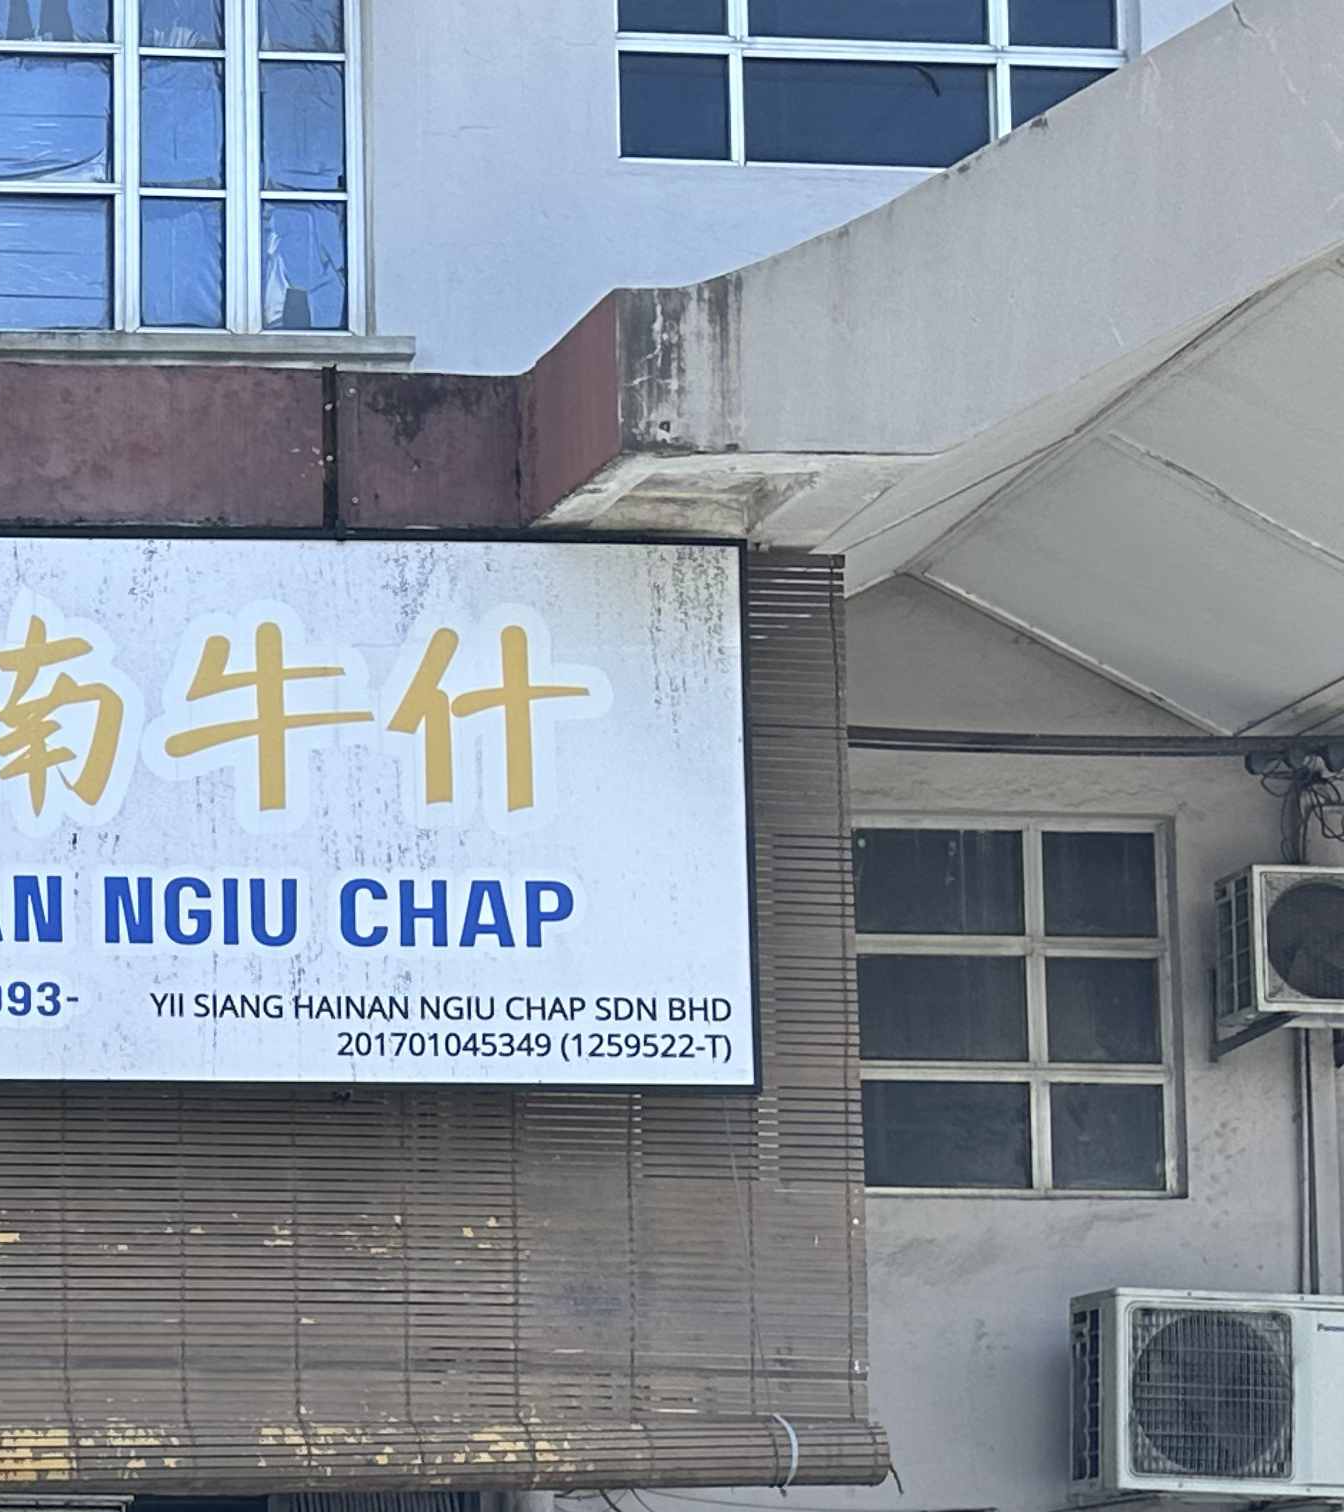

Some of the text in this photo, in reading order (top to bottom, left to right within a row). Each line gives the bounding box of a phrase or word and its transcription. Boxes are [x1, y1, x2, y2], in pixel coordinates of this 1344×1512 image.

[102, 874, 297, 948] NGIU
[338, 877, 574, 949] CHAP
[149, 992, 733, 1023] YII SIANG HAINAN NGIU CHAP SDN BHD
[336, 1031, 733, 1064] 201701045349 (1259522-T)
